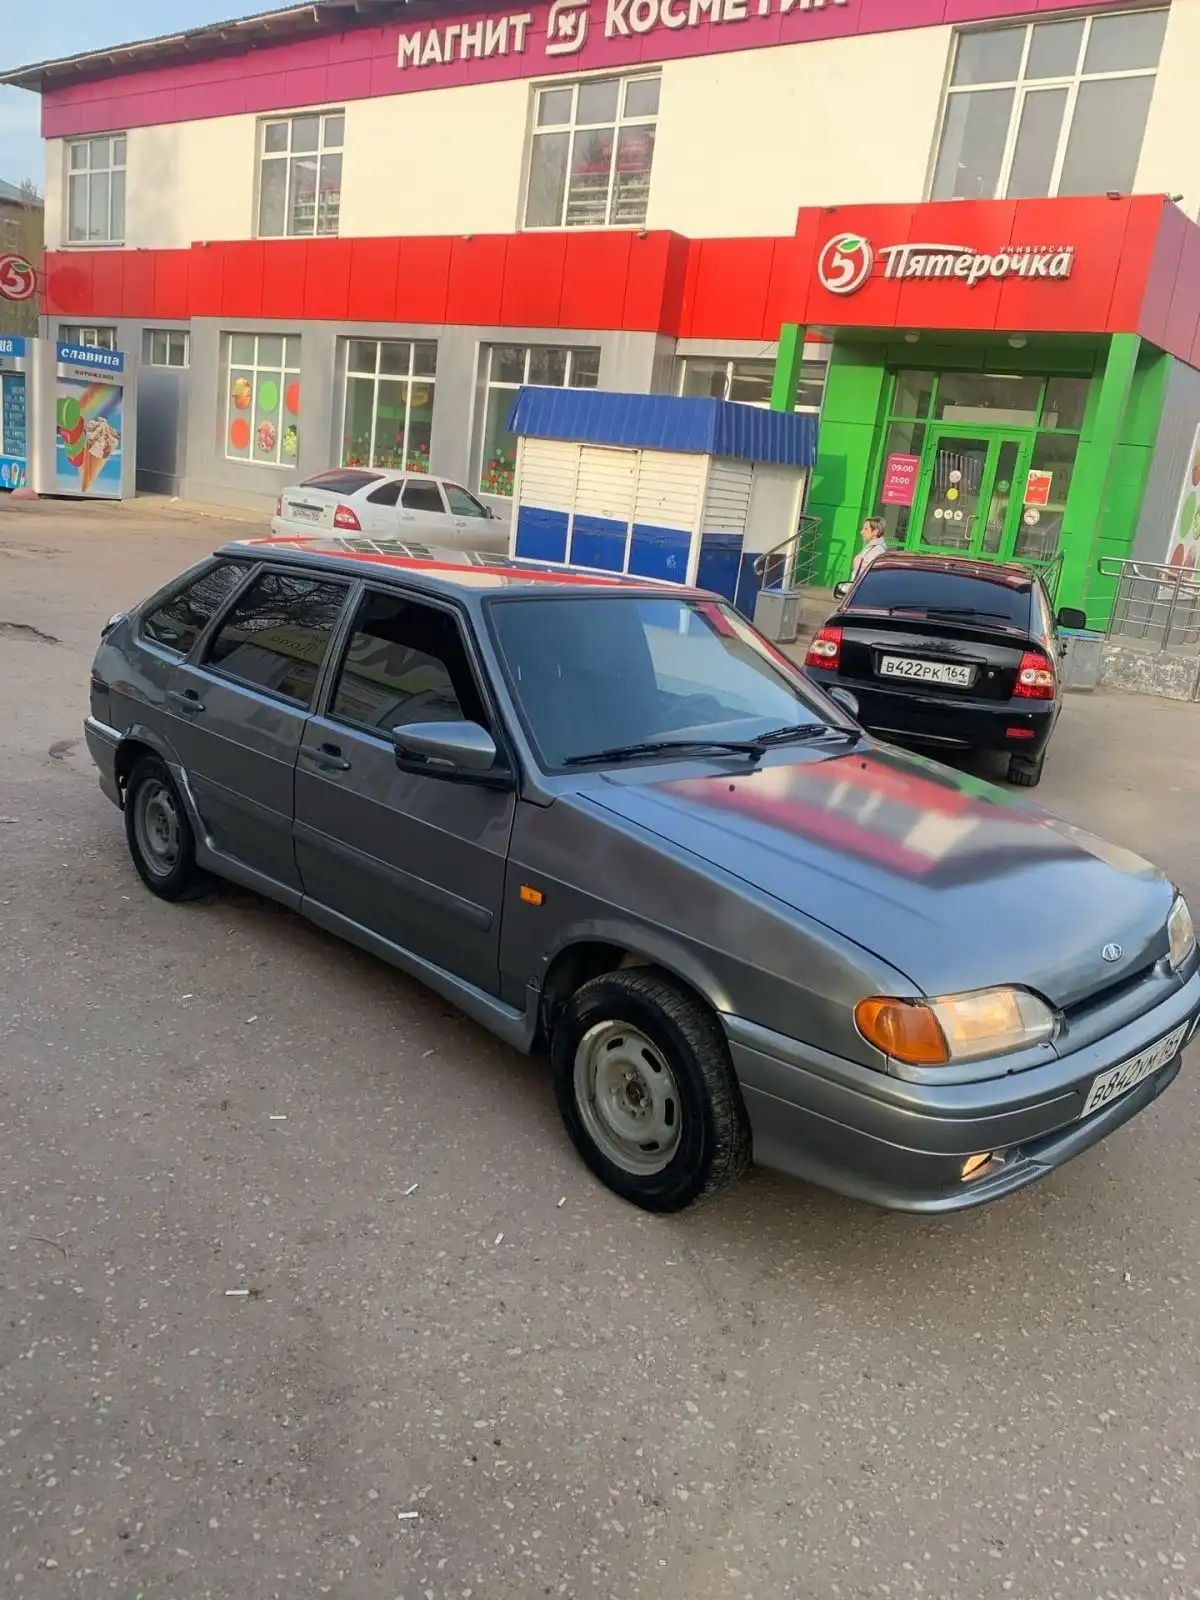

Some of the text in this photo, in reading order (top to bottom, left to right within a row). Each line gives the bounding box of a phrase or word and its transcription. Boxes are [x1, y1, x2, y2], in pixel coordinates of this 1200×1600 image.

[397, 12, 532, 69] МАГНИТ
[1000, 245, 1075, 254] УНИВЕРСАМ
[60, 348, 121, 366] славица
[891, 463, 914, 473] 09:00
[890, 475, 910, 485] 21:00
[886, 660, 967, 679] В422РК 164
